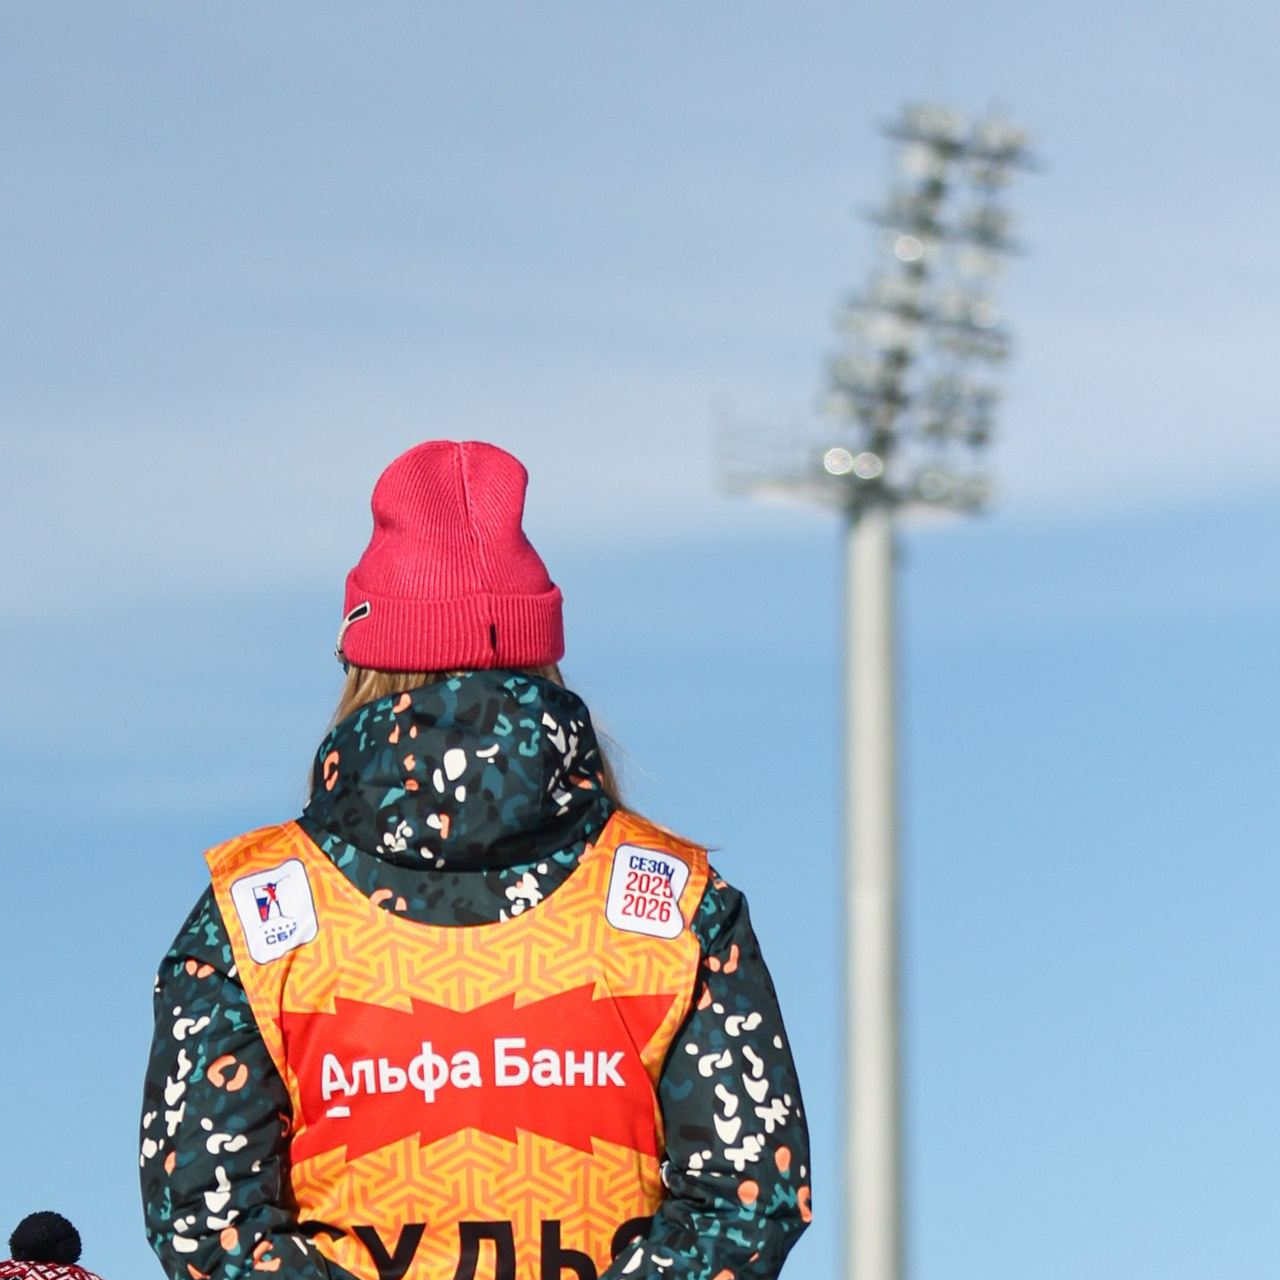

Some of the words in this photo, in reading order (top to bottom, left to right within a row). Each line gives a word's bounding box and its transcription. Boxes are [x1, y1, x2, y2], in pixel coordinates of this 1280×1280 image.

[626, 871, 674, 898] 2025
[621, 893, 672, 922] 2026
[321, 1041, 482, 1118] Альфа
[493, 1037, 626, 1089] Банк
